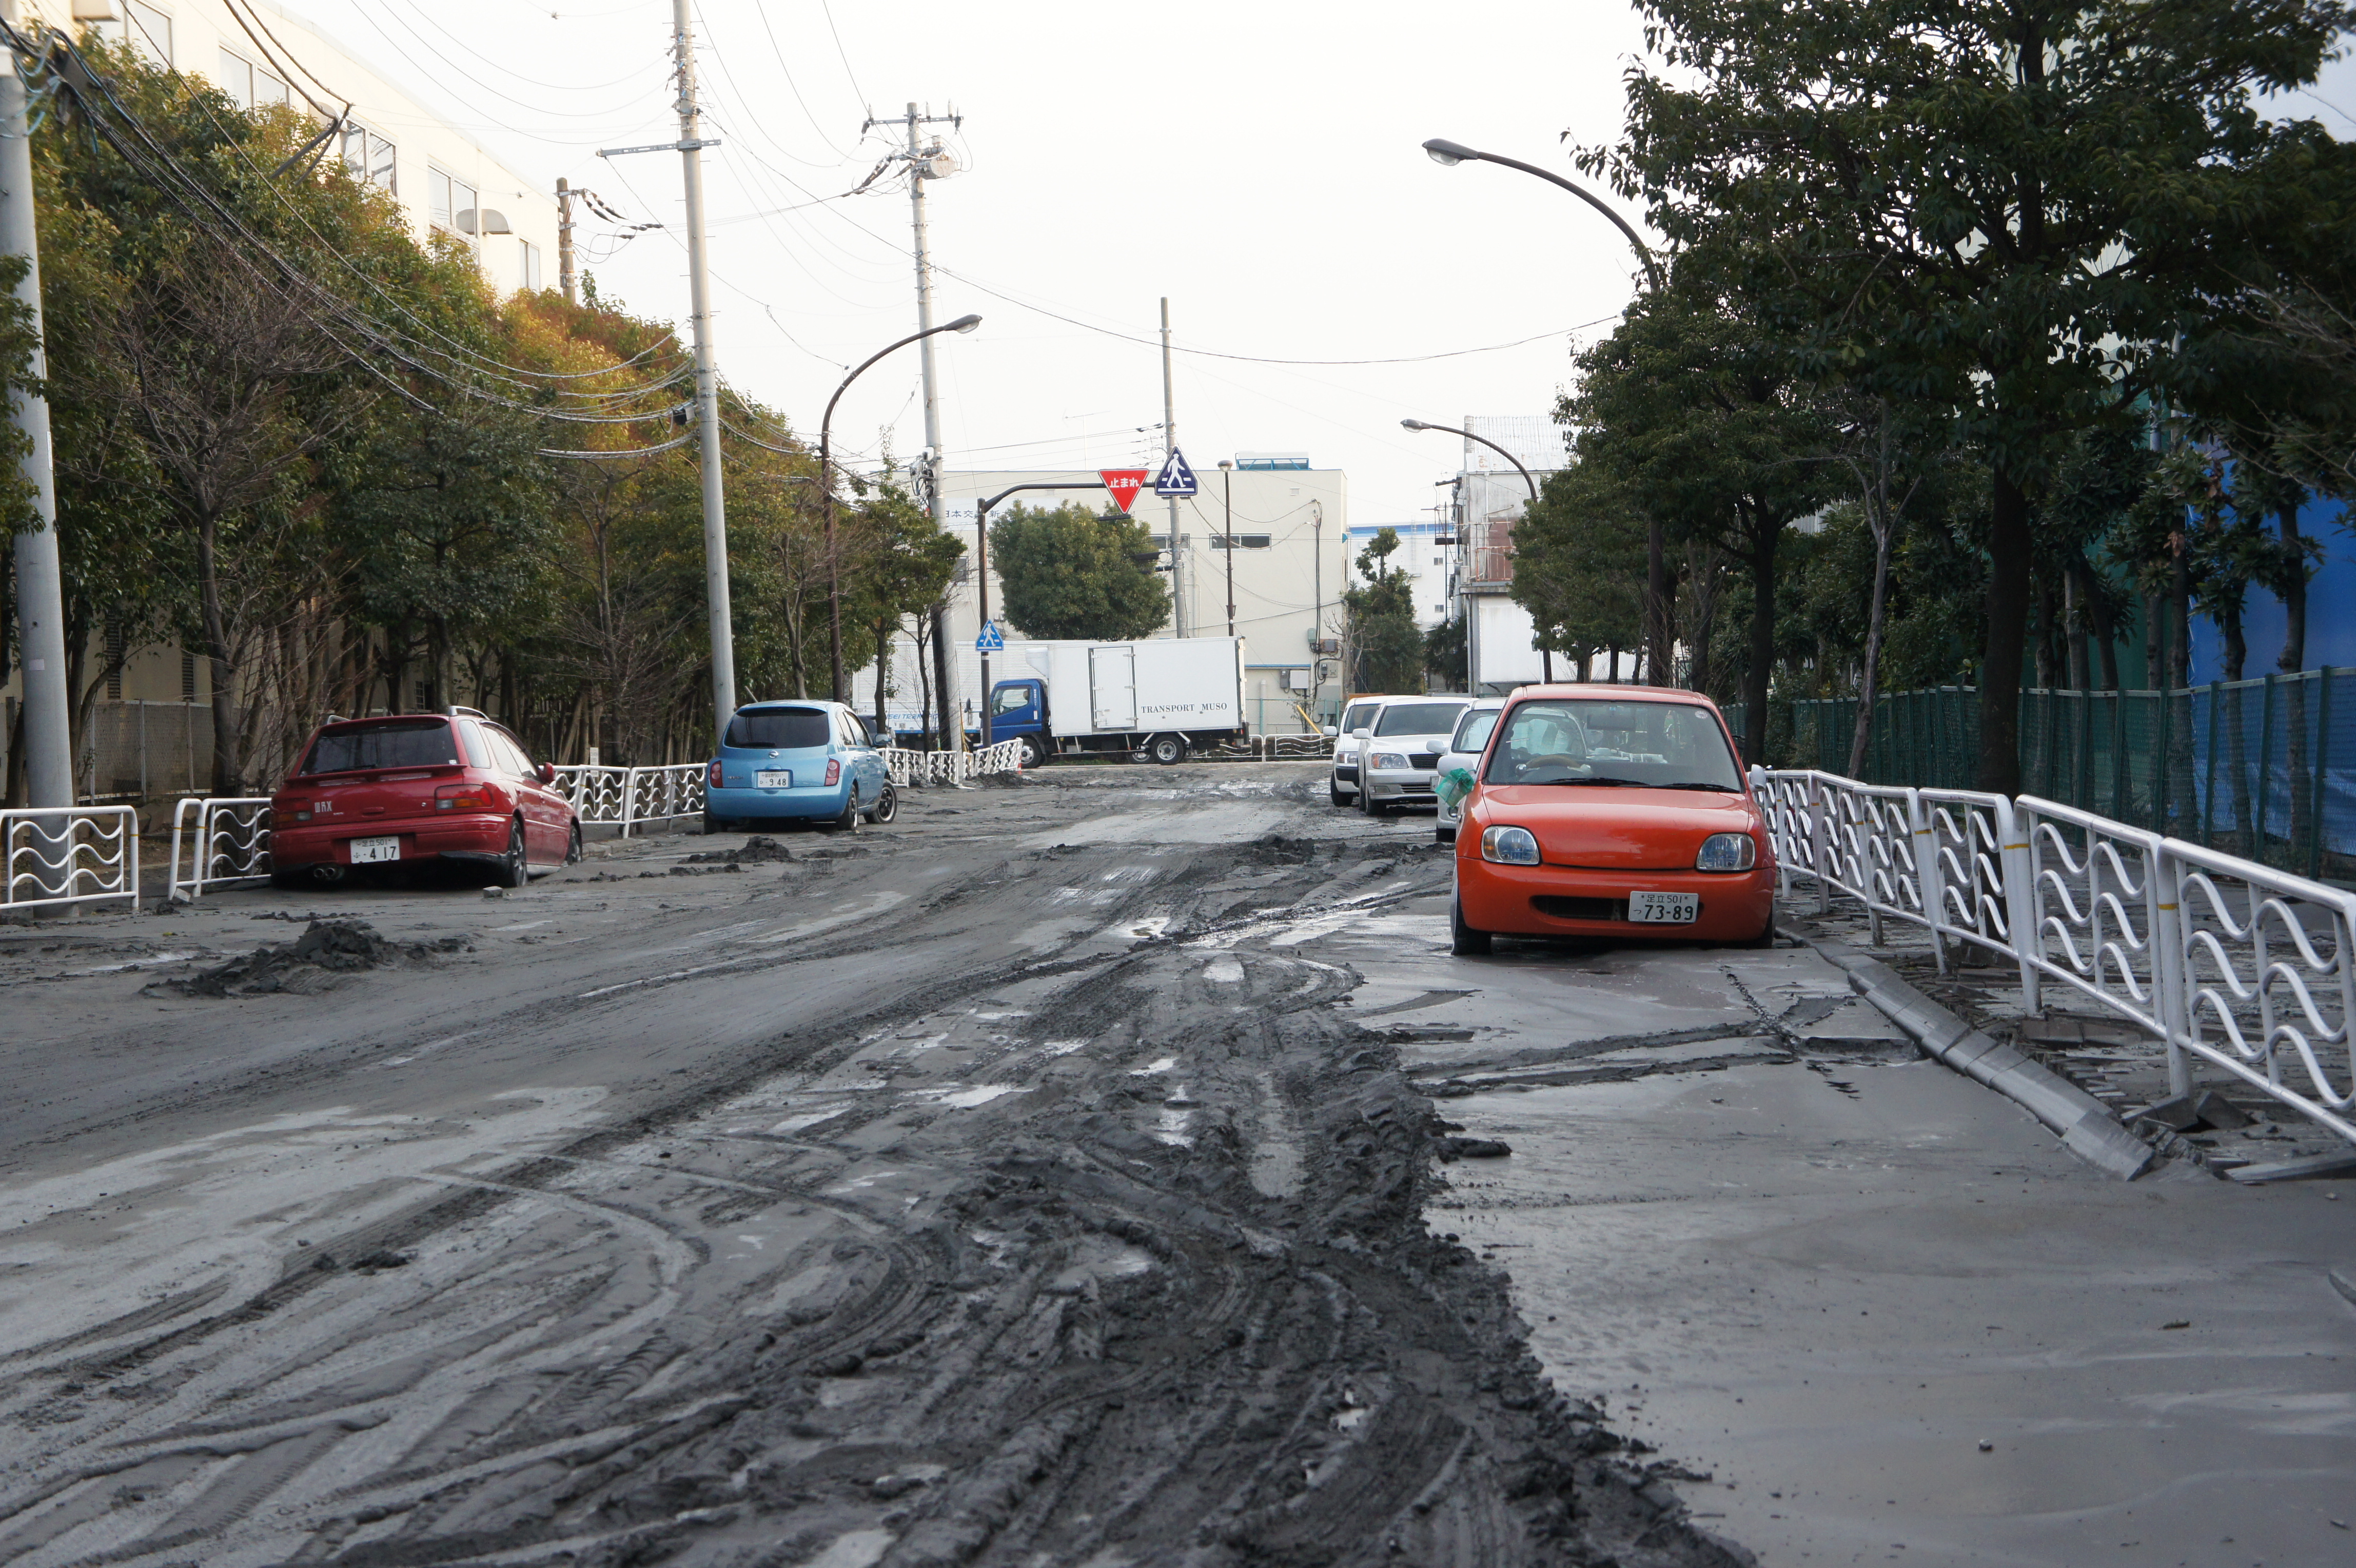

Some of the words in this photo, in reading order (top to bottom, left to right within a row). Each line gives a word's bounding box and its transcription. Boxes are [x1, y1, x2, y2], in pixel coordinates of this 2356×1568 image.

[1109, 477, 1140, 488] 止まれ
[1141, 703, 1194, 714] TRANSPORT
[1201, 702, 1227, 711] MUSO
[315, 800, 332, 813] WRX
[1644, 904, 1694, 920] 73-89
